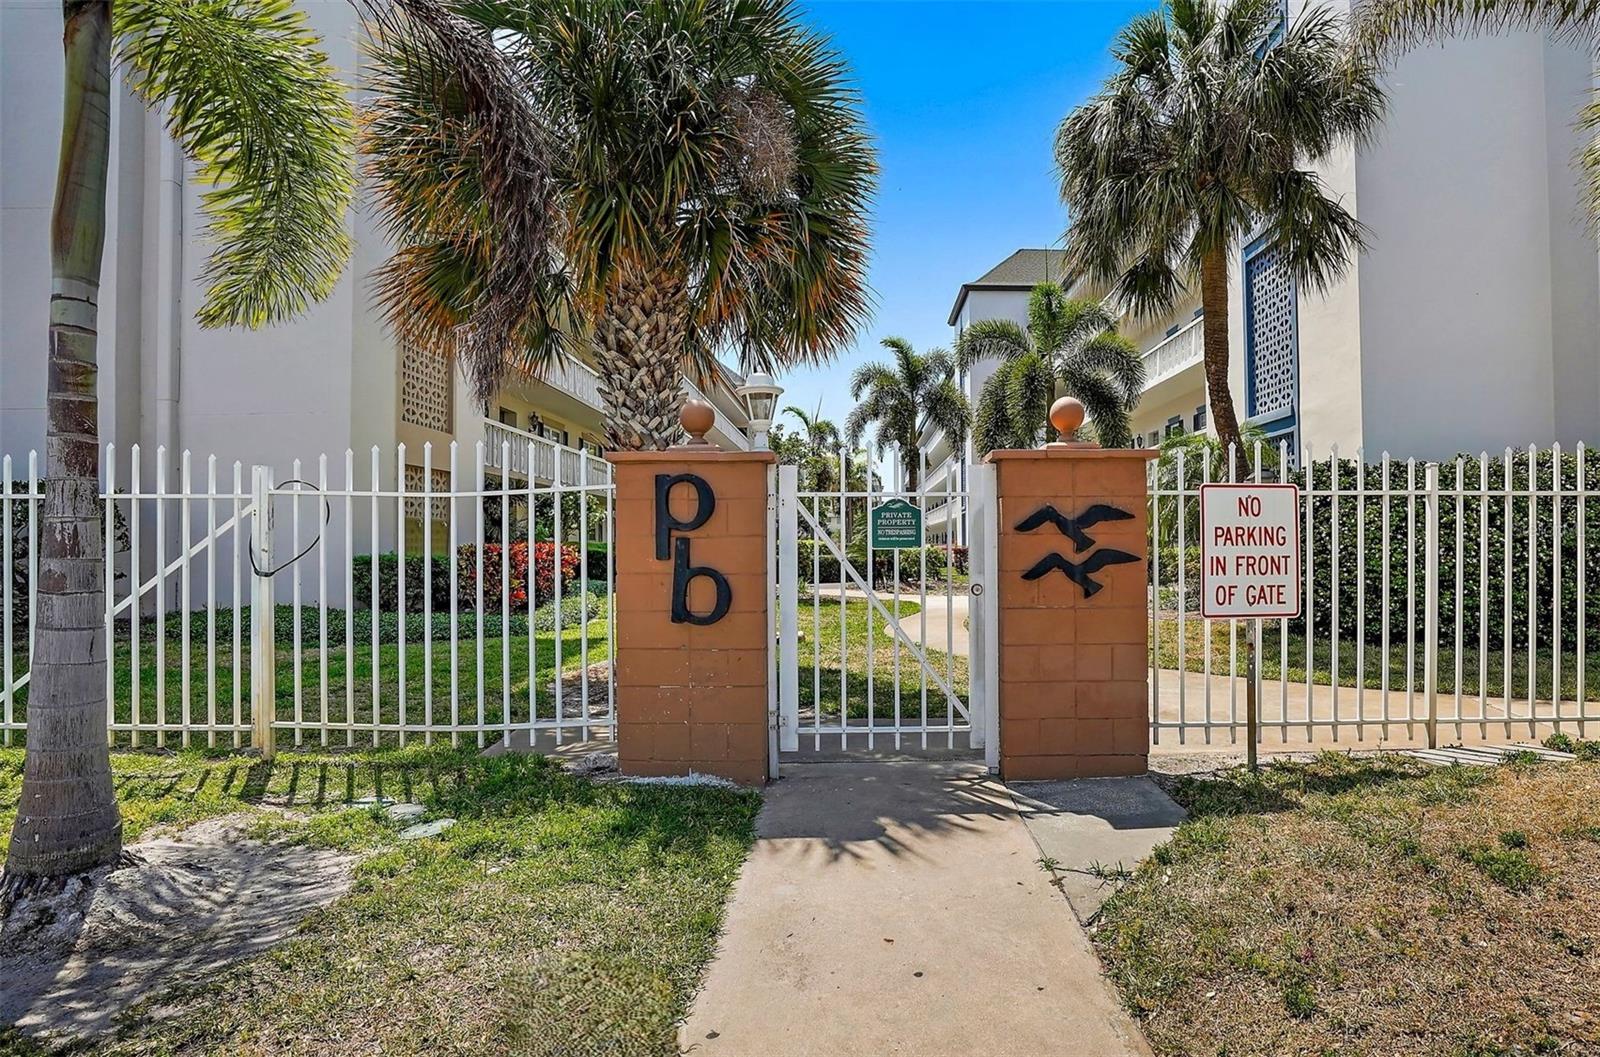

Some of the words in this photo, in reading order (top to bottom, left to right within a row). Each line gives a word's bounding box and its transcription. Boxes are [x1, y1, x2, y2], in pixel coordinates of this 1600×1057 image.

[1238, 497, 1261, 517] NO
[1214, 526, 1286, 547] PARKING
[1210, 556, 1226, 576] IN
[1236, 555, 1290, 576] FRONT
[1215, 585, 1238, 606] OF
[1246, 584, 1286, 606] GATE
